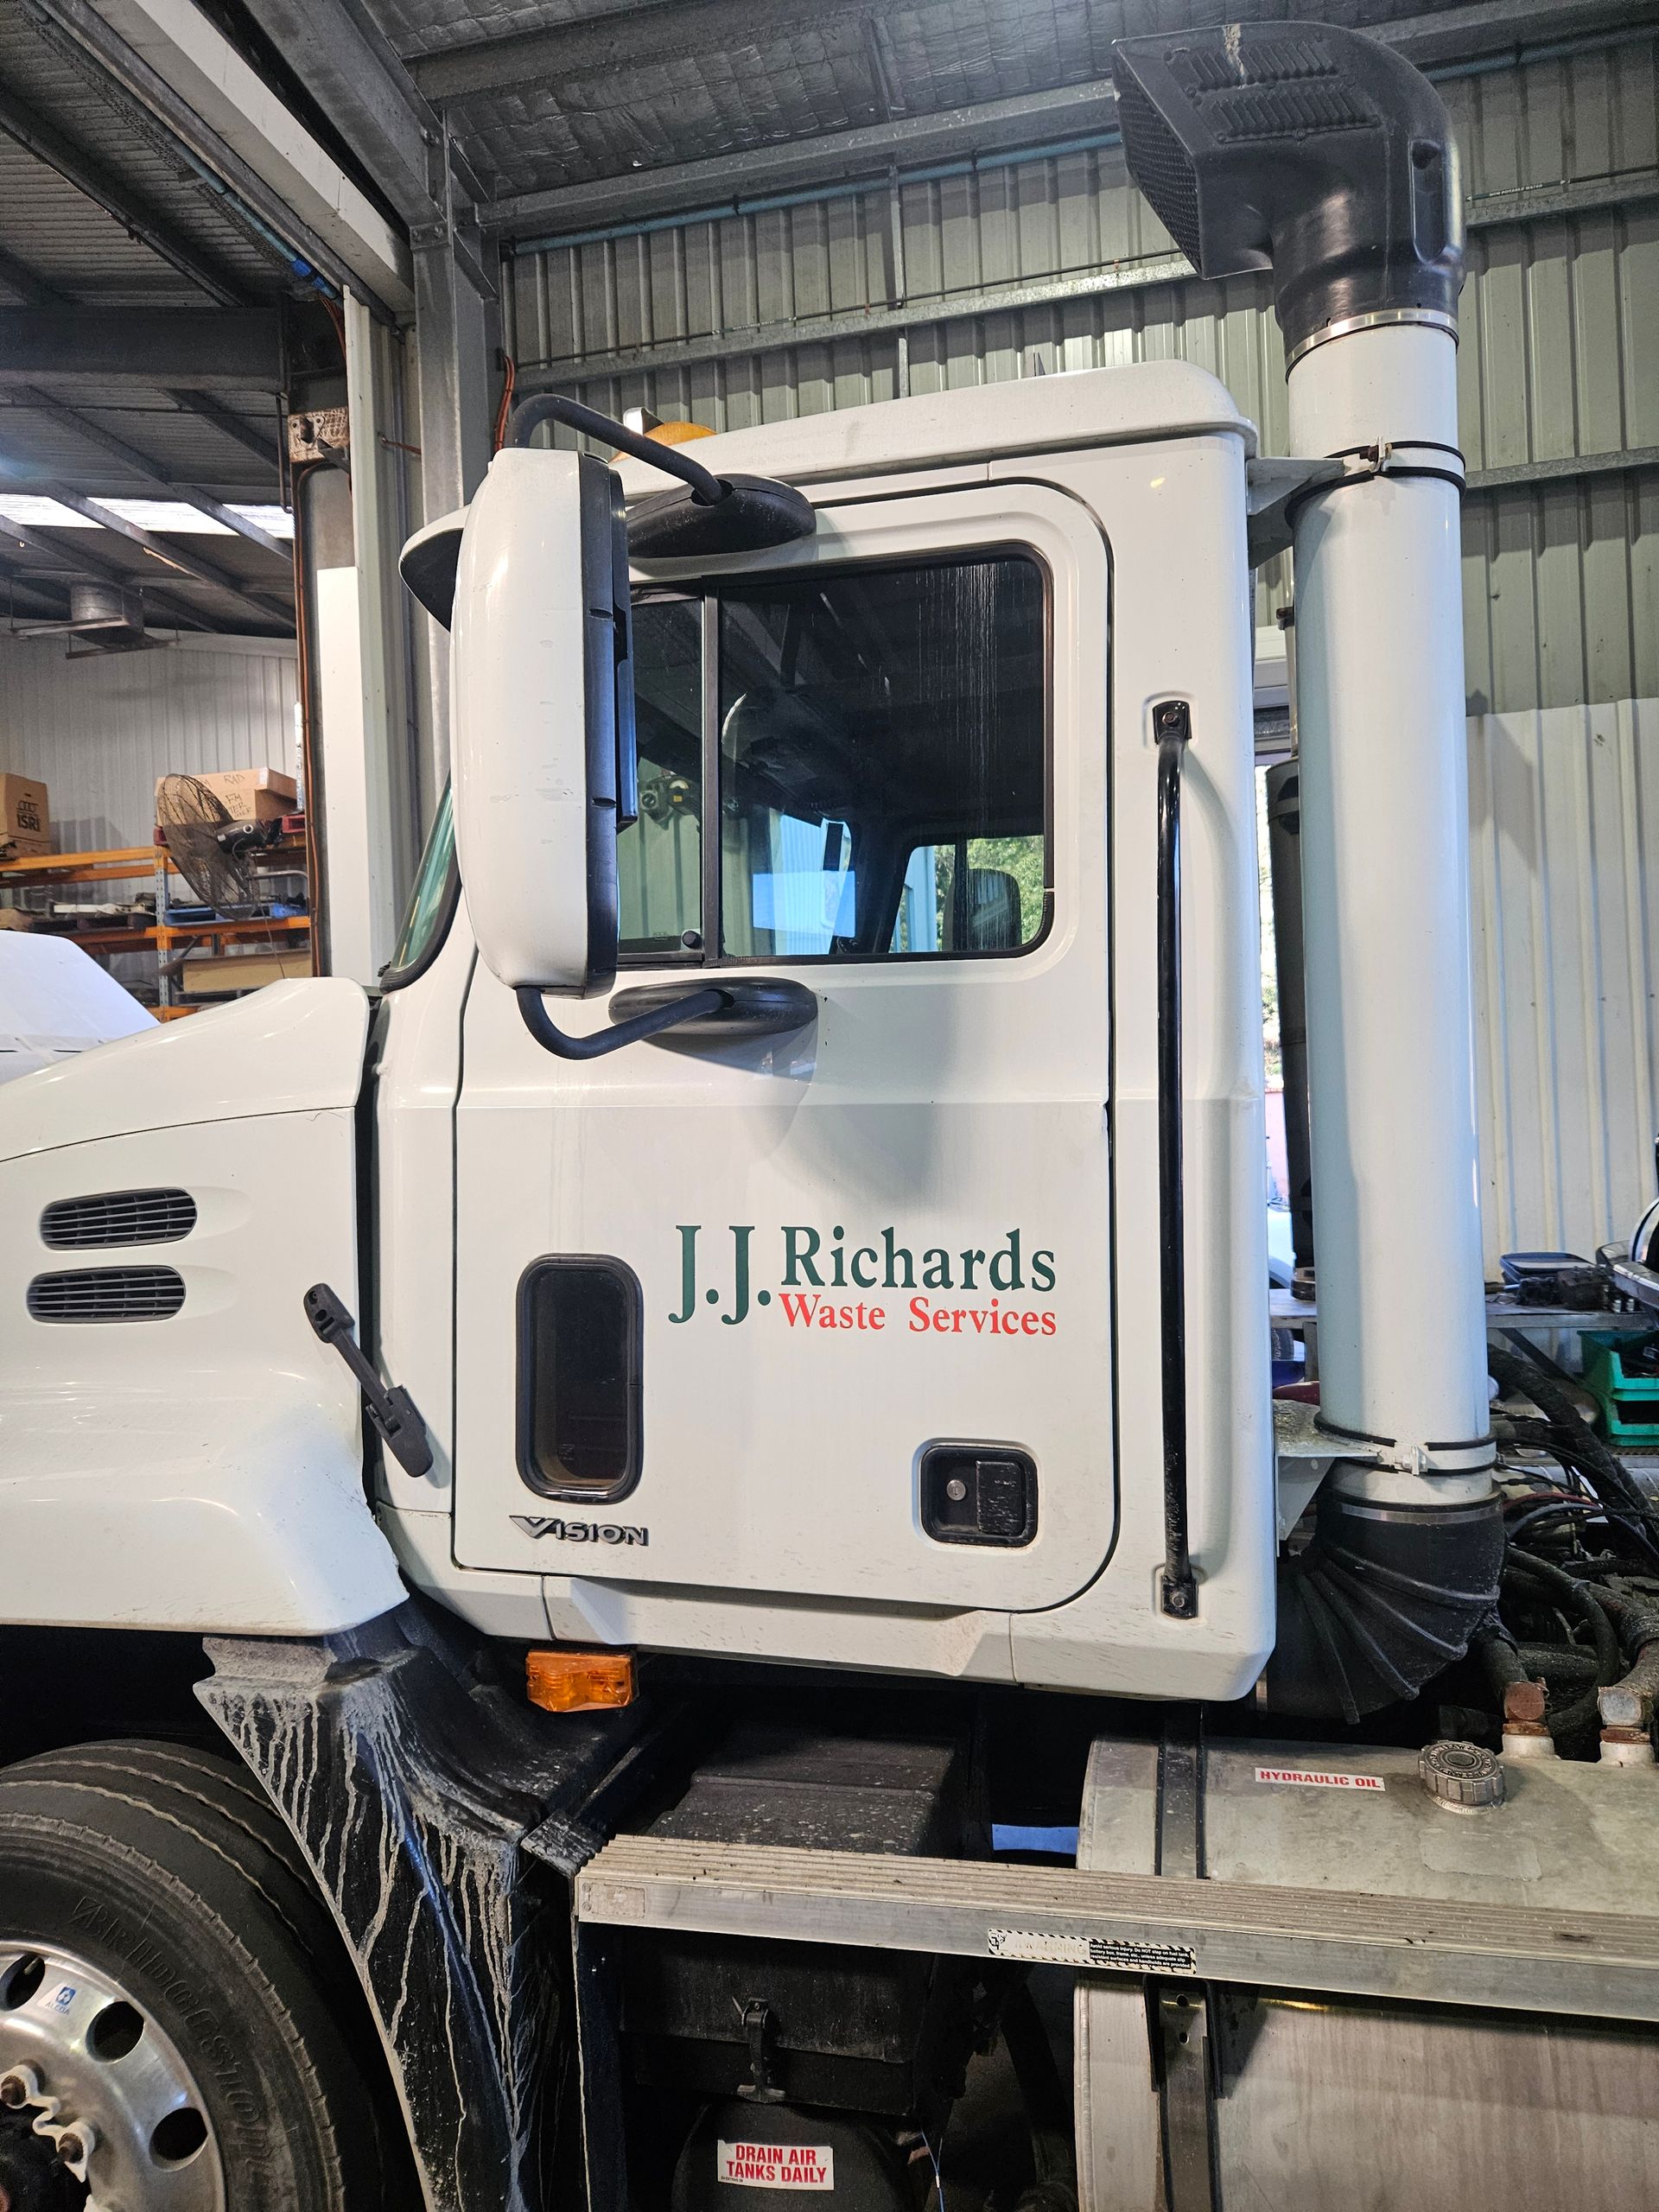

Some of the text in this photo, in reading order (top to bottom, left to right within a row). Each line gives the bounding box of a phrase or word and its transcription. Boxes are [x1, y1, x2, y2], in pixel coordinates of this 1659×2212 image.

[17, 813, 41, 833] ISRI
[668, 1224, 1057, 1325] J.J. Richards
[779, 1293, 1057, 1336] Waste Services
[509, 1515, 649, 1547] VISION
[1260, 1770, 1381, 1788] HYDRAULIC OIL
[735, 2144, 817, 2165] DRAIN AIR
[727, 2160, 827, 2183] TANKS DAILY
